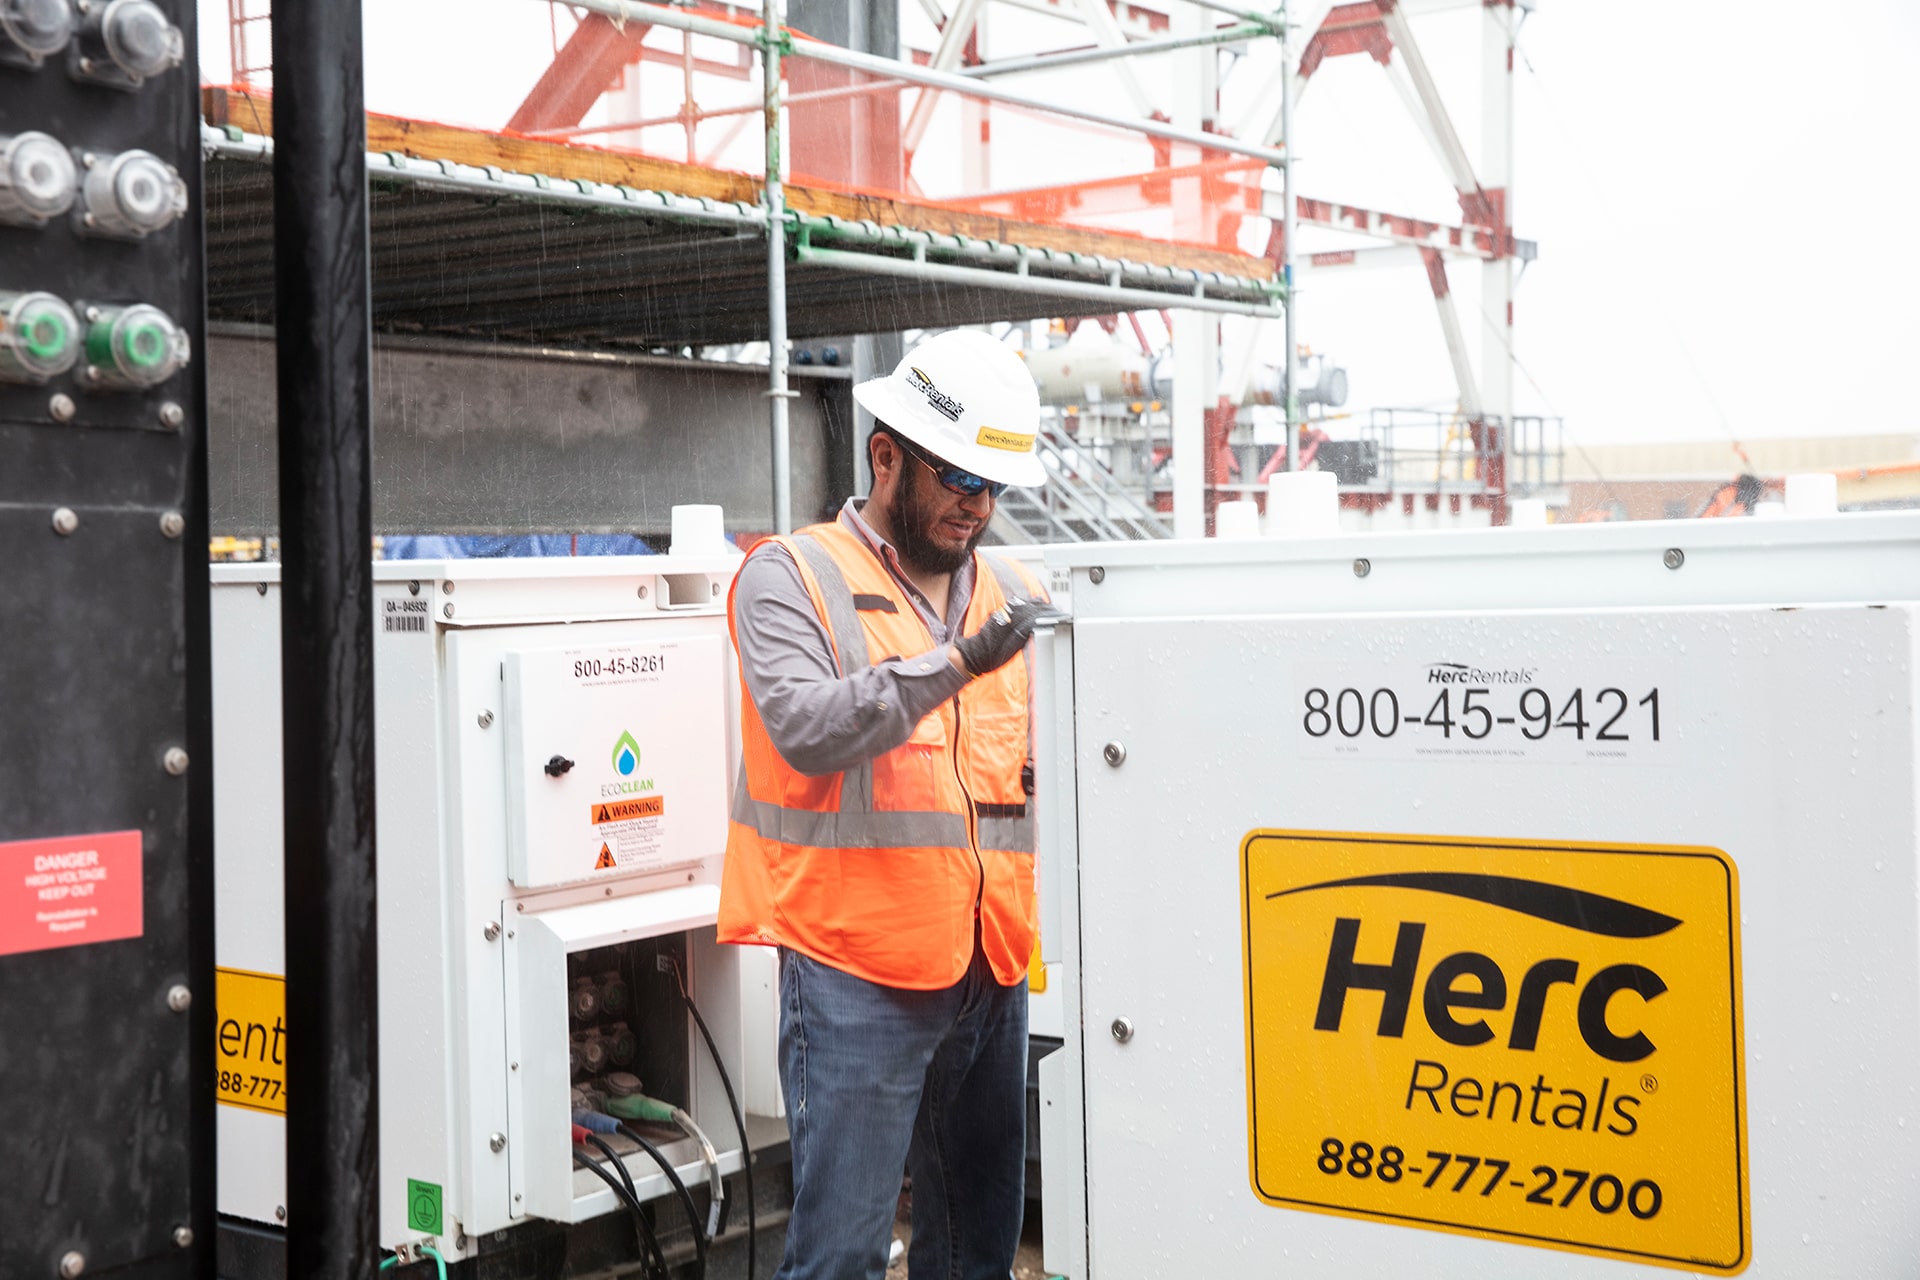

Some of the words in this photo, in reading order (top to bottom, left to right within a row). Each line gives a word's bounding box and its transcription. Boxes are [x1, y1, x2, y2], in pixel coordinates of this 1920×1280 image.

[574, 654, 664, 678] 800-45-8261
[1302, 687, 1661, 742] 800-45-9421
[600, 778, 655, 797] ECOCLEAN
[611, 800, 660, 818] WARNING
[34, 850, 99, 872] DANGER
[1314, 917, 1669, 1063] Herc
[216, 1009, 286, 1066] ent
[216, 1068, 287, 1101] 88-777-
[1317, 1137, 1663, 1220] 888-777-2700
